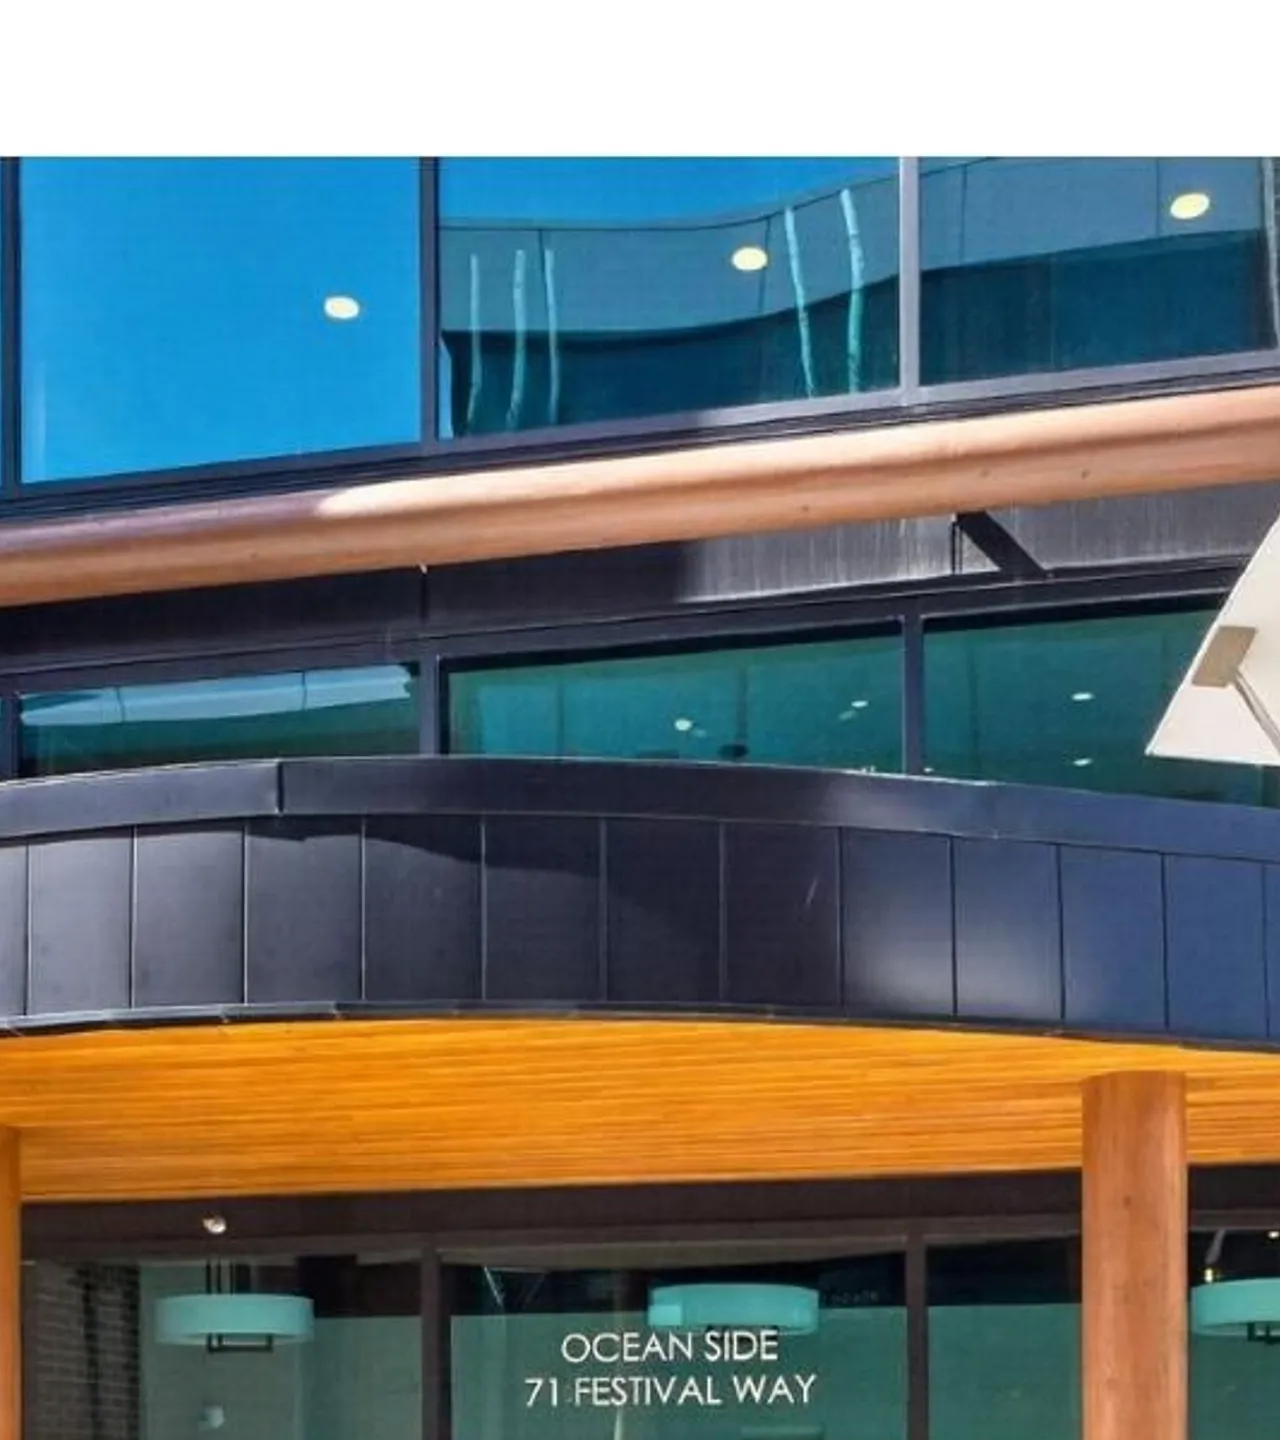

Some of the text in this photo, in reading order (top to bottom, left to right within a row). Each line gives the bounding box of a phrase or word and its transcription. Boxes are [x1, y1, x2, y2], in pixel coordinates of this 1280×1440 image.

[560, 1329, 779, 1363] OCEAN SIDE
[524, 1372, 817, 1408] 71 FESTIVAL WAY
